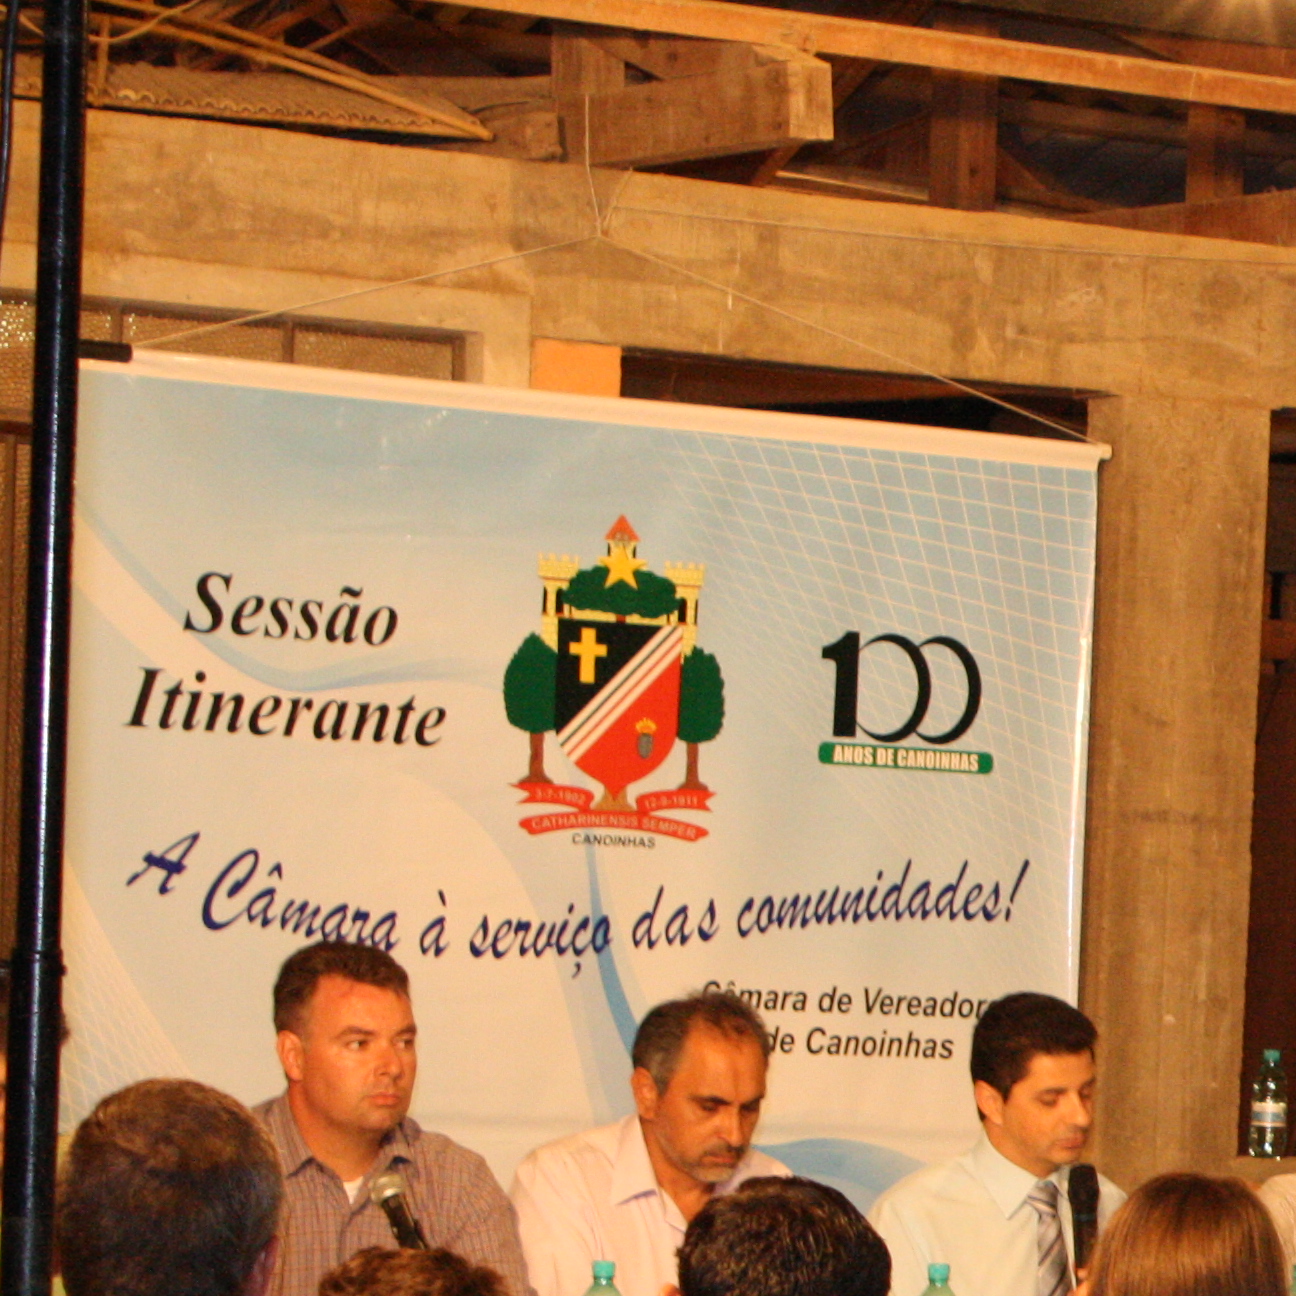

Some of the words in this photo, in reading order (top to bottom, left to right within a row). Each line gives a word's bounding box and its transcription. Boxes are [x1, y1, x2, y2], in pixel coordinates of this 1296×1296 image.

[183, 571, 398, 646] Sessão
[125, 667, 447, 747] Itinerante
[833, 744, 873, 766] ANOS
[876, 747, 895, 766] DE
[897, 748, 980, 772] CANOINHAS
[531, 813, 639, 829] CATHARINENSIS
[641, 816, 697, 839] SEMPER
[571, 832, 656, 849] CANOINHAS
[126, 831, 200, 895] A
[201, 848, 402, 953] Câmara
[419, 889, 450, 958] à
[469, 902, 613, 979] serviço
[632, 884, 721, 950] das
[736, 858, 1031, 939] comunidades!
[818, 986, 853, 1014] de
[863, 986, 989, 1020] Vereador
[766, 1026, 795, 1053] de
[806, 1027, 954, 1060] Canoinhas
